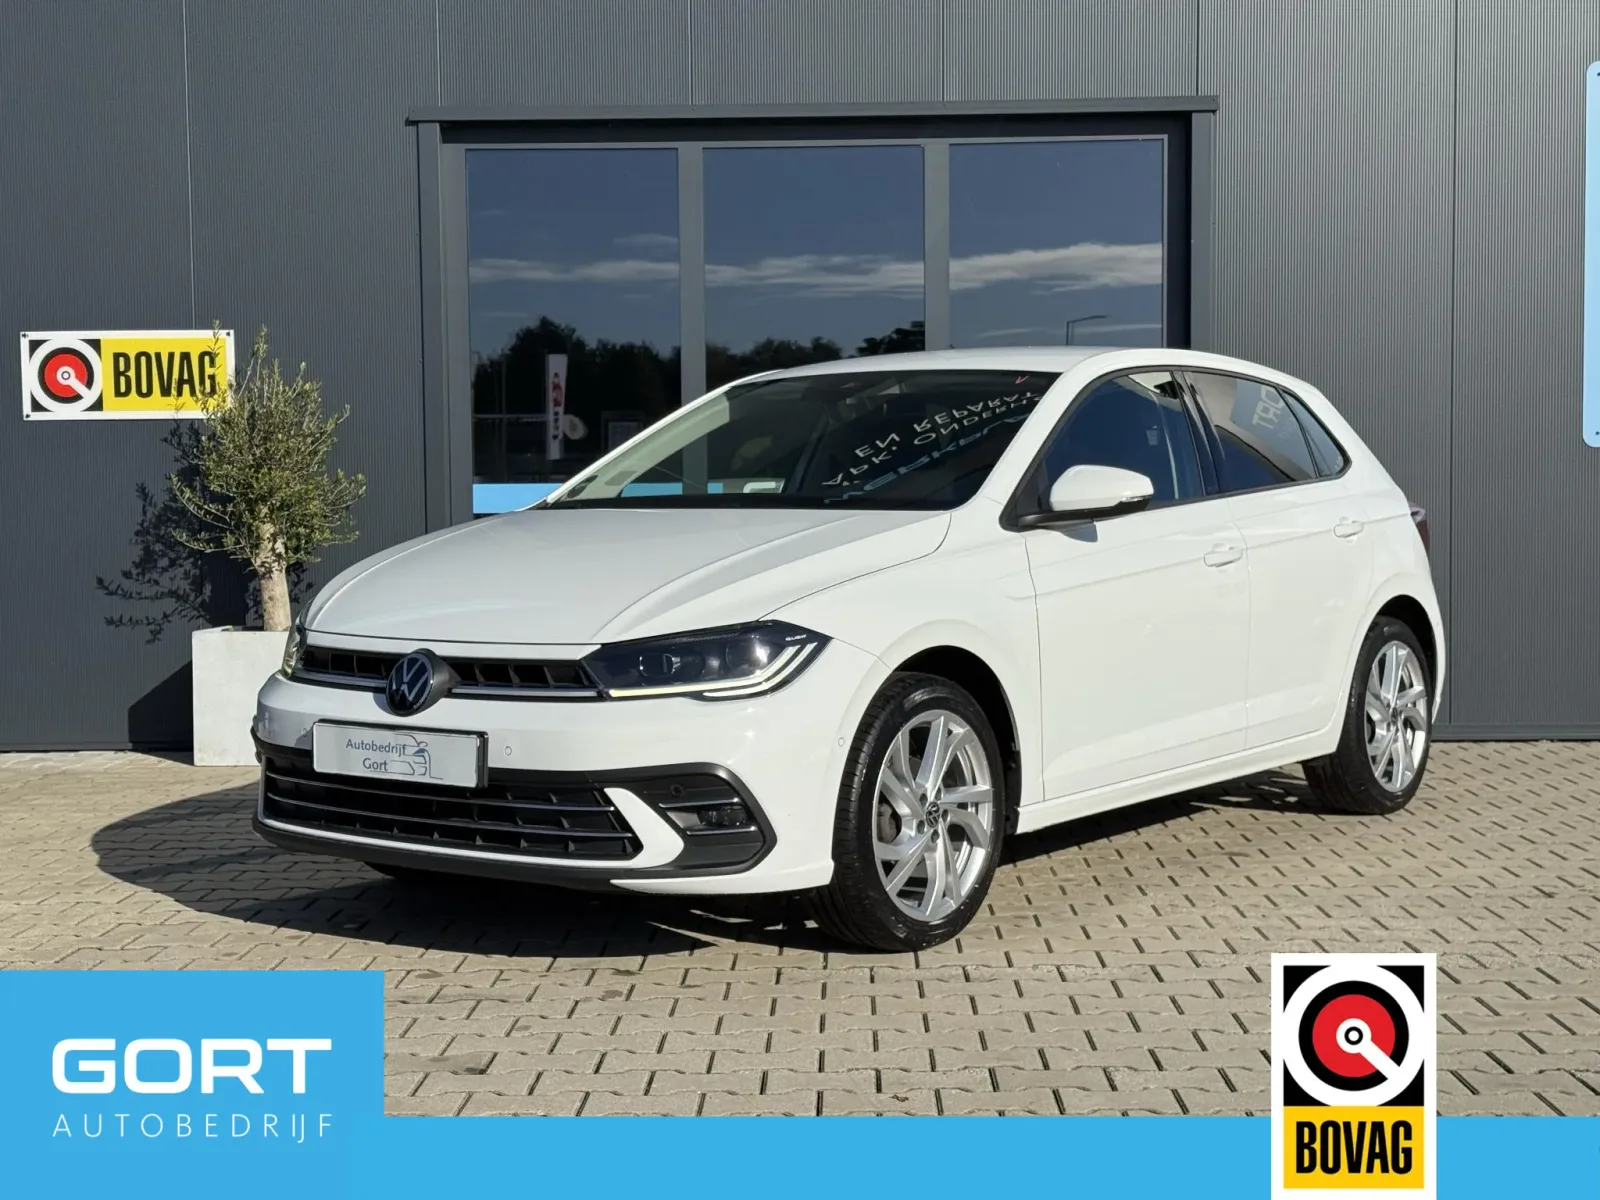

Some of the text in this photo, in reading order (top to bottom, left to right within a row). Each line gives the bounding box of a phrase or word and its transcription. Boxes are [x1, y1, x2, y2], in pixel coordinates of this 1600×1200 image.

[112, 351, 217, 398] BOVAG
[345, 738, 407, 757] Autobedrijf
[362, 757, 389, 772] Gort
